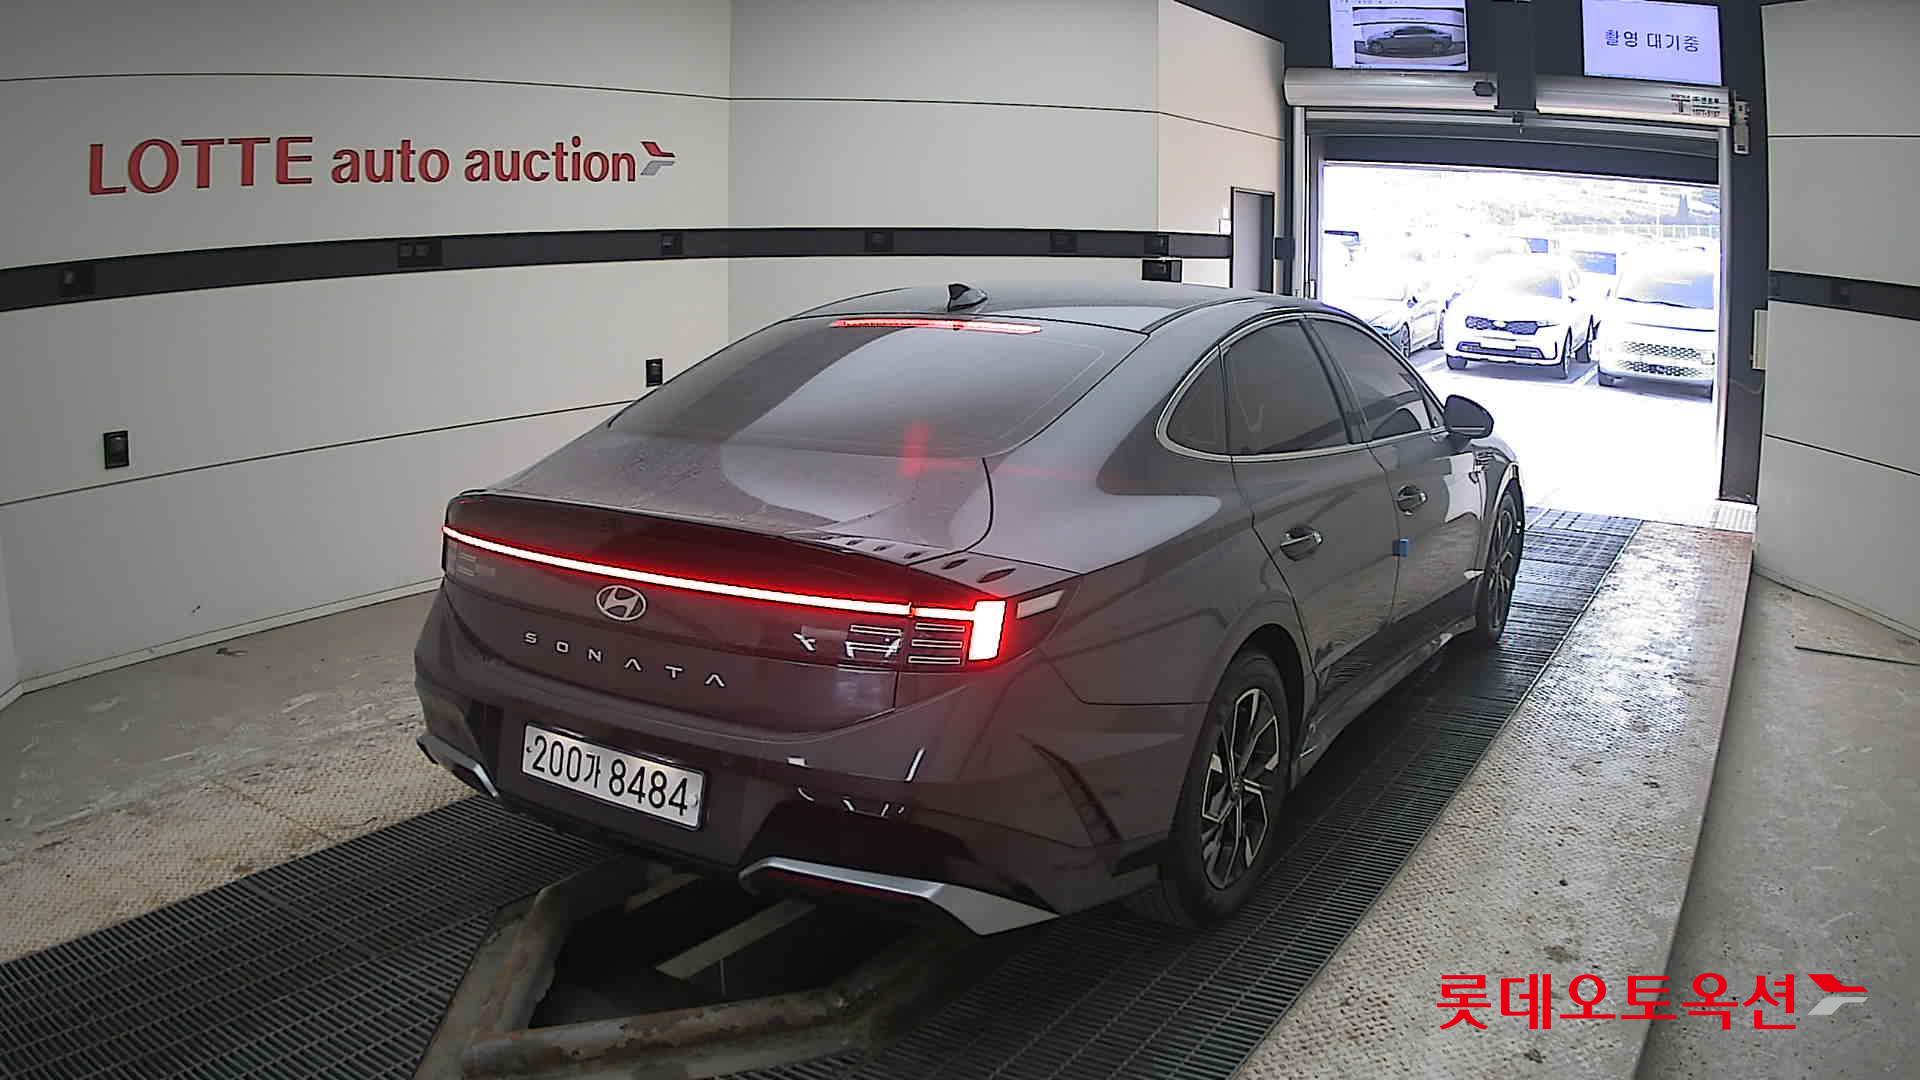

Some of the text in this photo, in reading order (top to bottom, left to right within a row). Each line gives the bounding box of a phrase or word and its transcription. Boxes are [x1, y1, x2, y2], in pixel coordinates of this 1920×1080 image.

[1606, 29, 1699, 52] 촬영 대기중
[89, 135, 637, 196] LOTTE auto auction
[524, 632, 725, 687] SONATA
